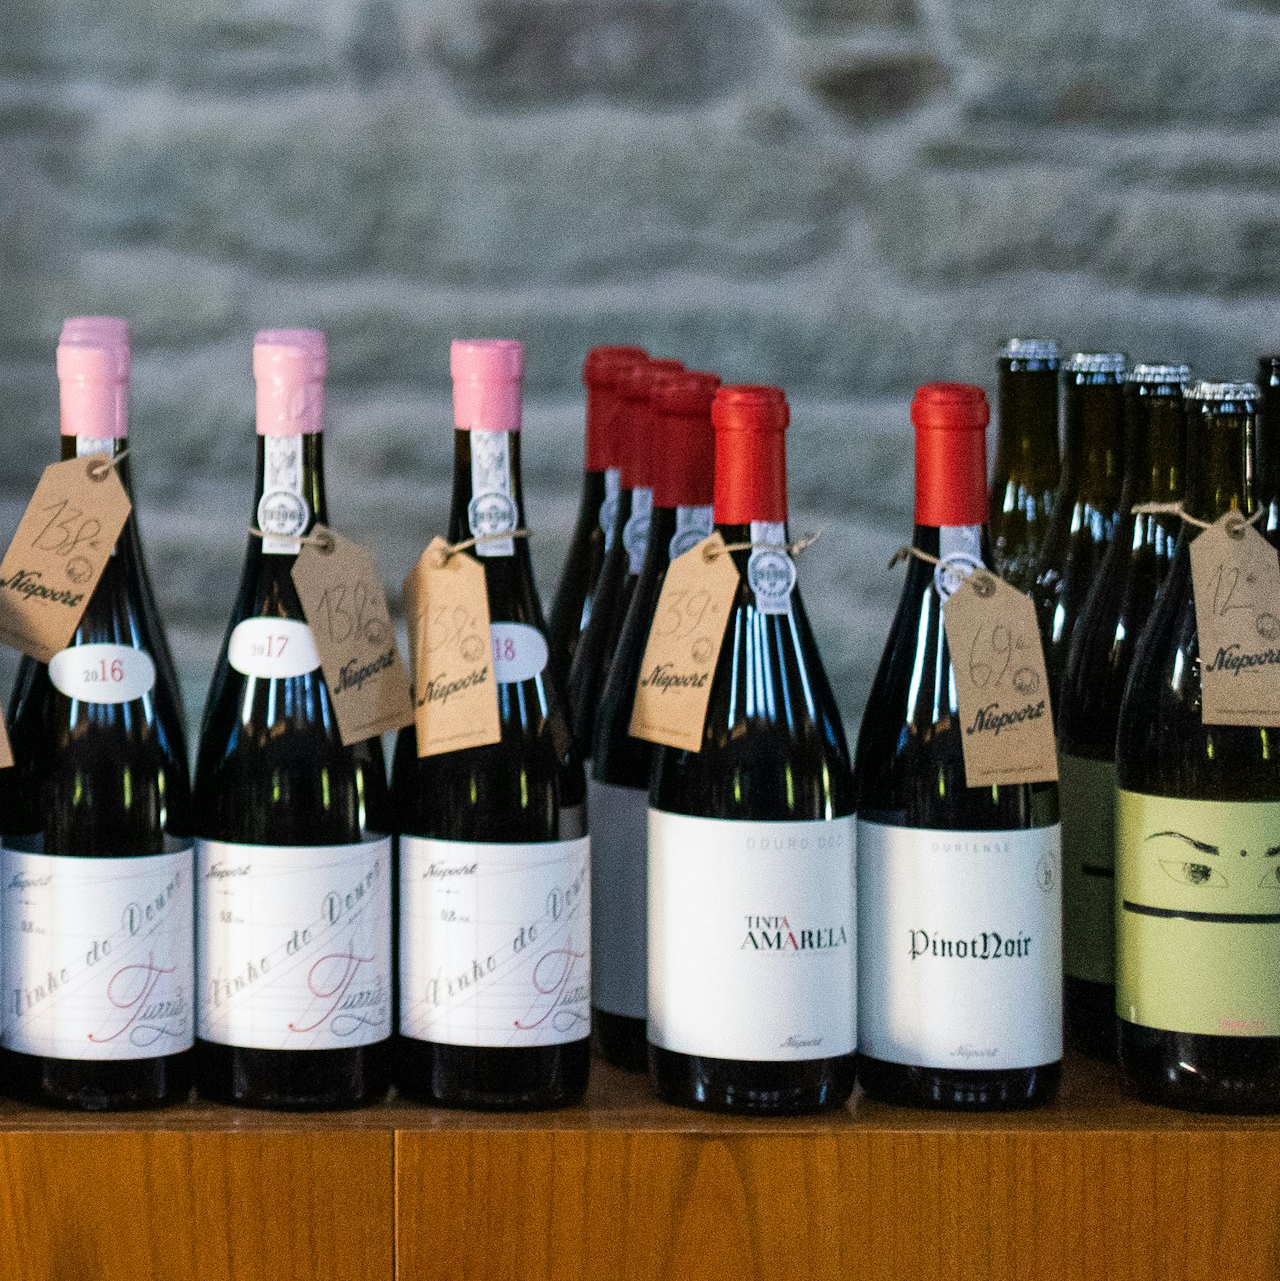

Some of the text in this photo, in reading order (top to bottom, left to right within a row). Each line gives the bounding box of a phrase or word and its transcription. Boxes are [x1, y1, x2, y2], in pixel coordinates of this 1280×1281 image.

[83, 659, 126, 684] 2016
[641, 663, 709, 694] Niepoort
[418, 670, 488, 707] Niepoort
[966, 700, 1045, 735] Niepoort
[744, 915, 790, 930] TINTA
[741, 926, 848, 951] AMARELA
